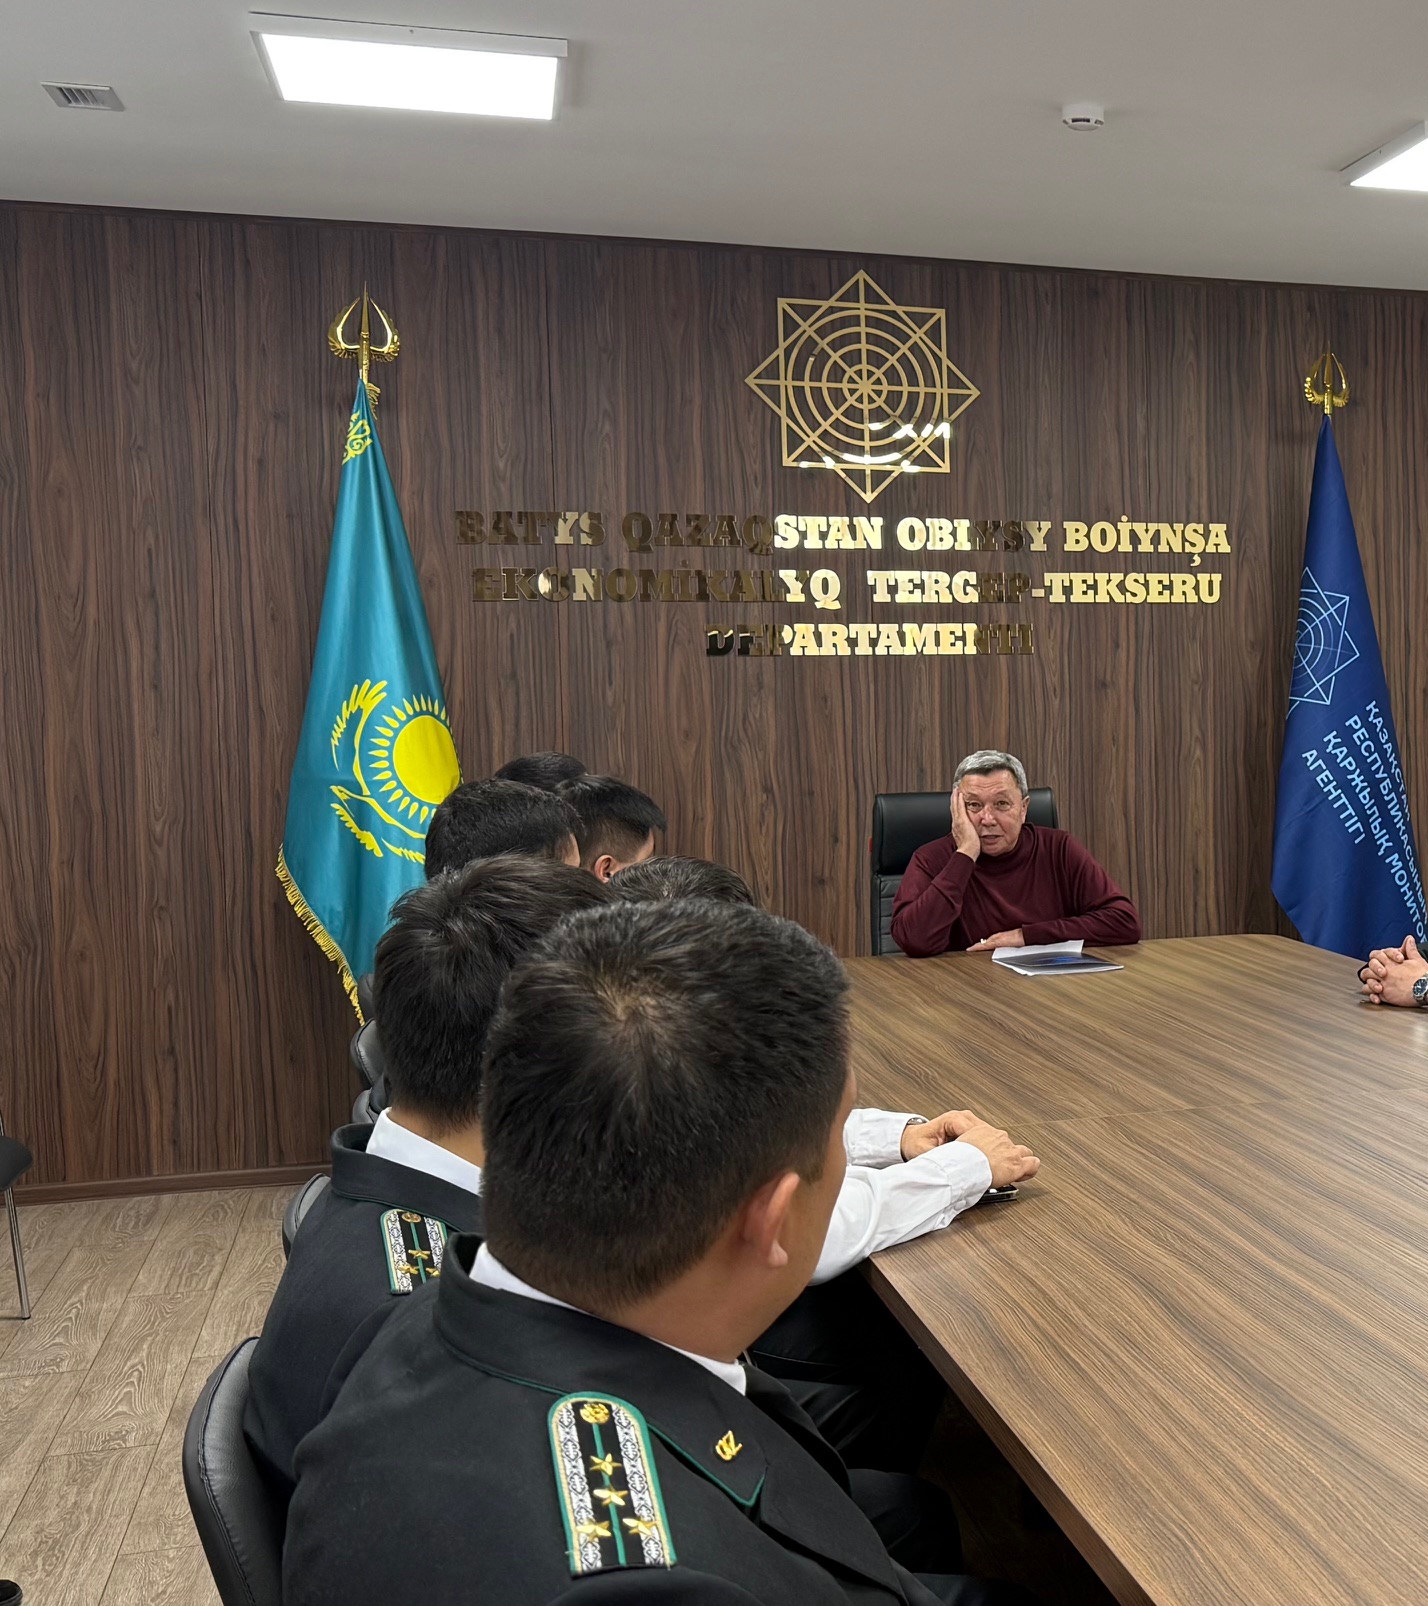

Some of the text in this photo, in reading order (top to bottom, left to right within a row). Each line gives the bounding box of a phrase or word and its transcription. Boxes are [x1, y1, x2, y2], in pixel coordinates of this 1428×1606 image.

[455, 511, 606, 546] BATYS
[621, 512, 884, 555] QAZAQSTAN
[705, 623, 1034, 657] DEPARTAMENTI
[1302, 749, 1366, 844] АГЕНТТІГІ
[1323, 731, 1393, 856] ҚАРЖЫЛЫҚ
